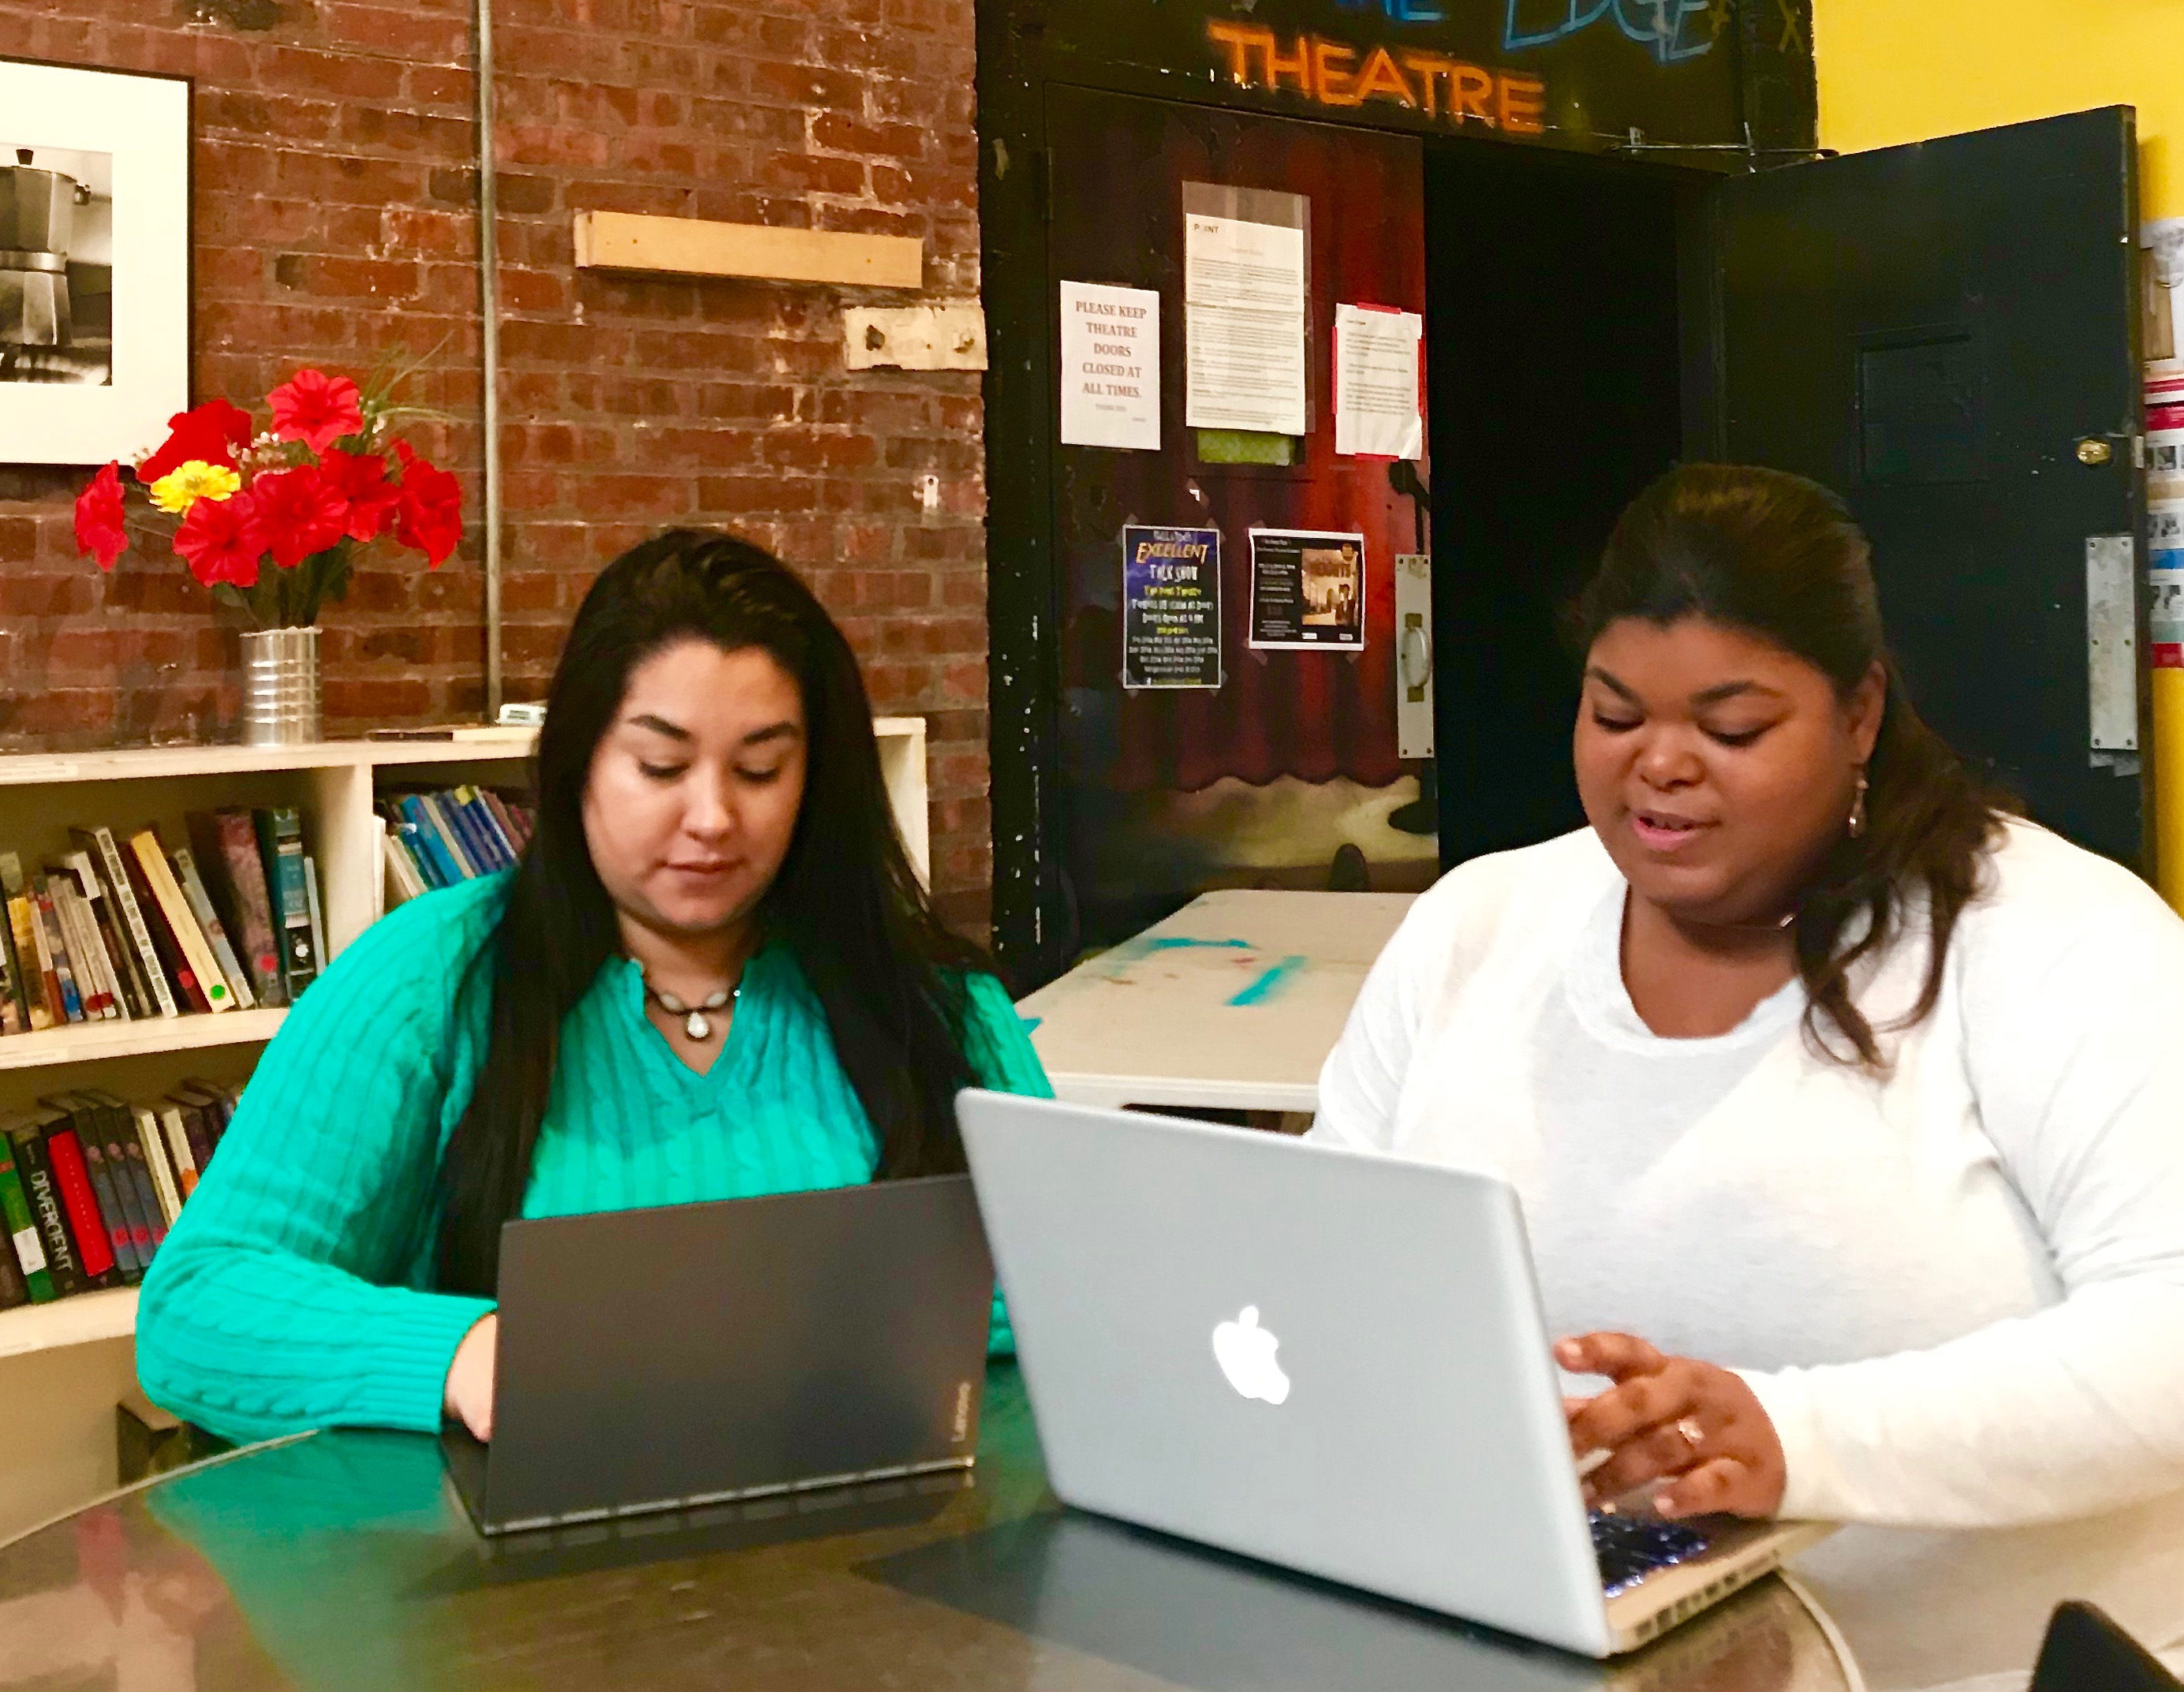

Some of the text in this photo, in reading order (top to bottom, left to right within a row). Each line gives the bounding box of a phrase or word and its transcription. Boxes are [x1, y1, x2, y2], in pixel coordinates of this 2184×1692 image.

[1207, 22, 1545, 134] THEATRE
[1194, 223, 1219, 233] PINT
[1076, 301, 1147, 319] PLEASE KEEP
[1086, 322, 1138, 338] THEATRE
[1094, 342, 1132, 357] DOORS
[1082, 362, 1142, 378] CLOSED AT
[1082, 382, 1103, 395] ALL
[1136, 542, 1209, 564] EXCELLENT
[31, 1170, 73, 1271] DIVERGENT
